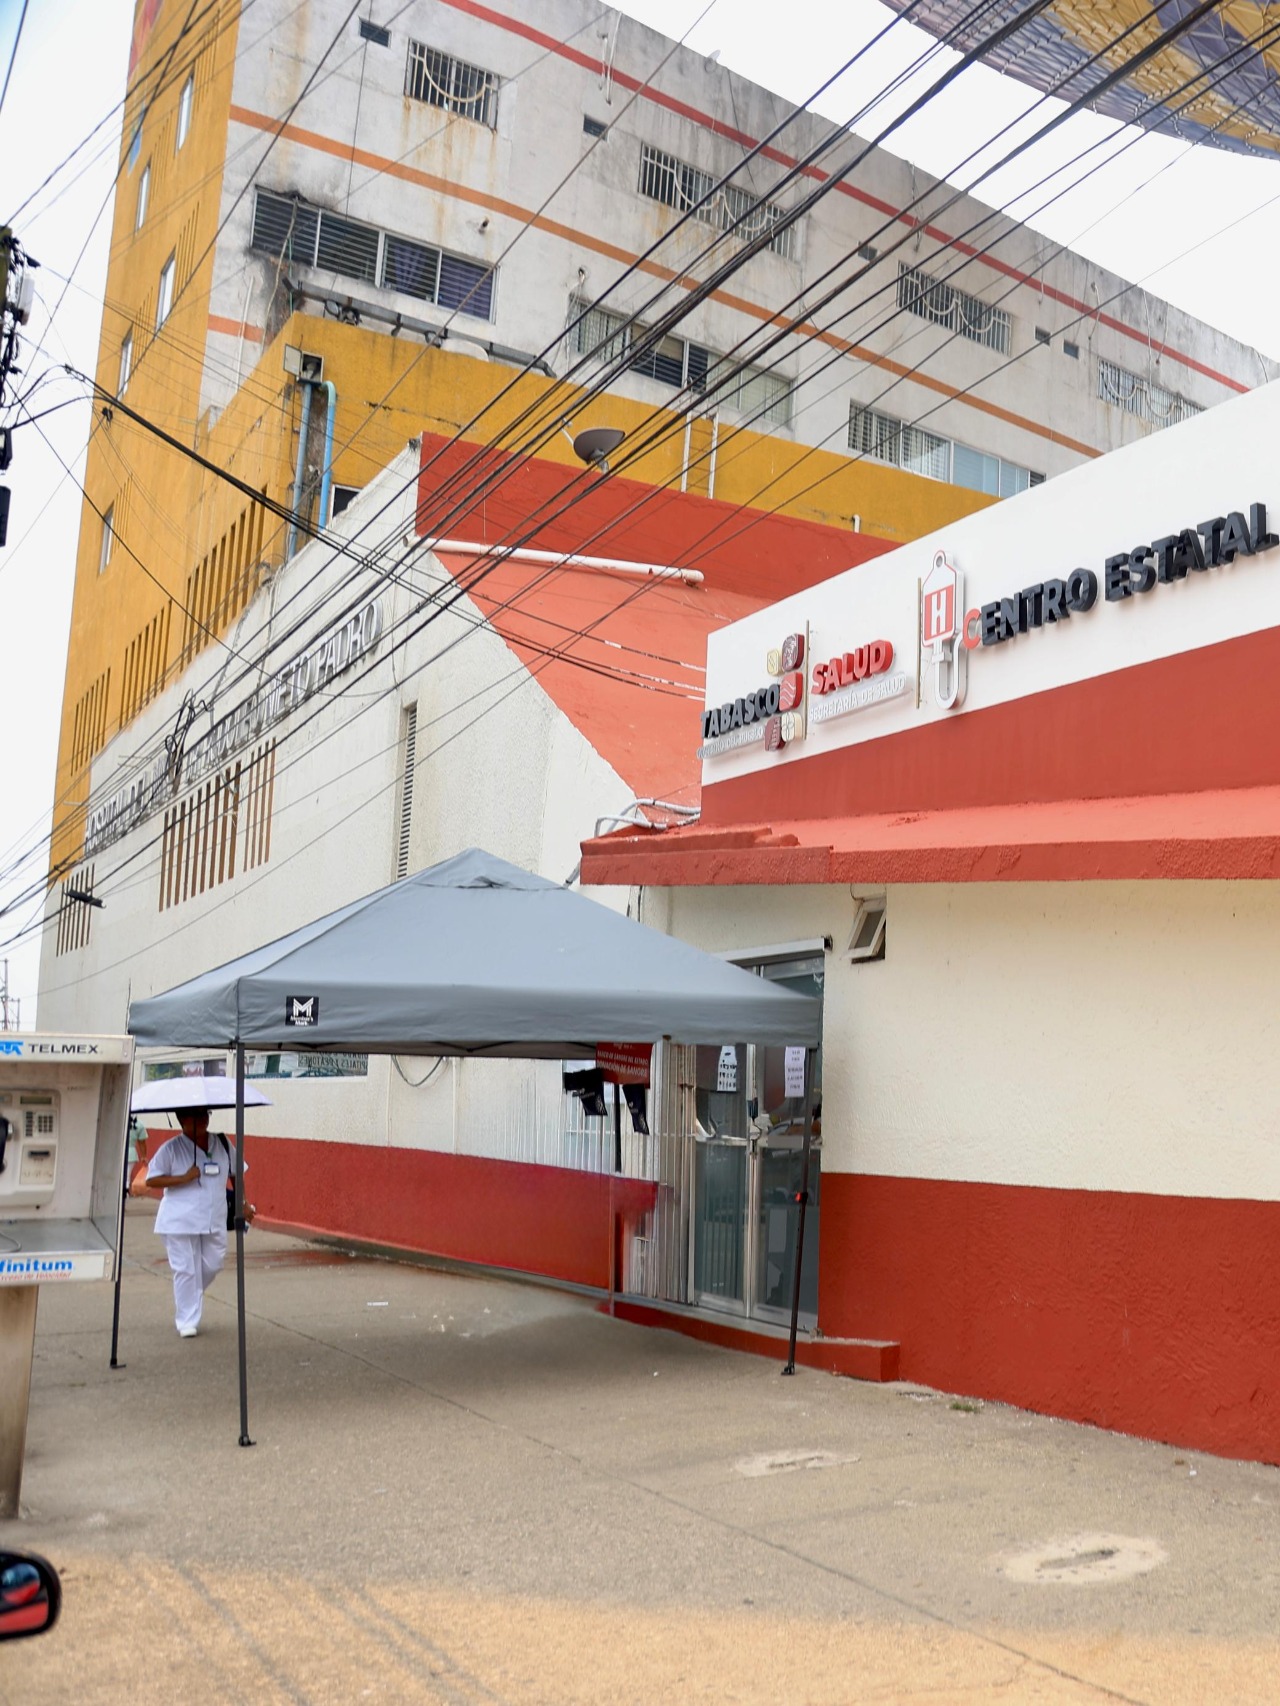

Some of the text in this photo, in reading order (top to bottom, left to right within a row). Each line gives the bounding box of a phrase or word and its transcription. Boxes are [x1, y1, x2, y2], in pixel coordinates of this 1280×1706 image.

[963, 566, 1098, 649] CENTRO
[1104, 502, 1279, 602] ESTATAL
[811, 640, 893, 694] SALUD
[701, 684, 780, 738] TABASCO
[861, 689, 875, 704] DE
[28, 1043, 99, 1054] TELMEX
